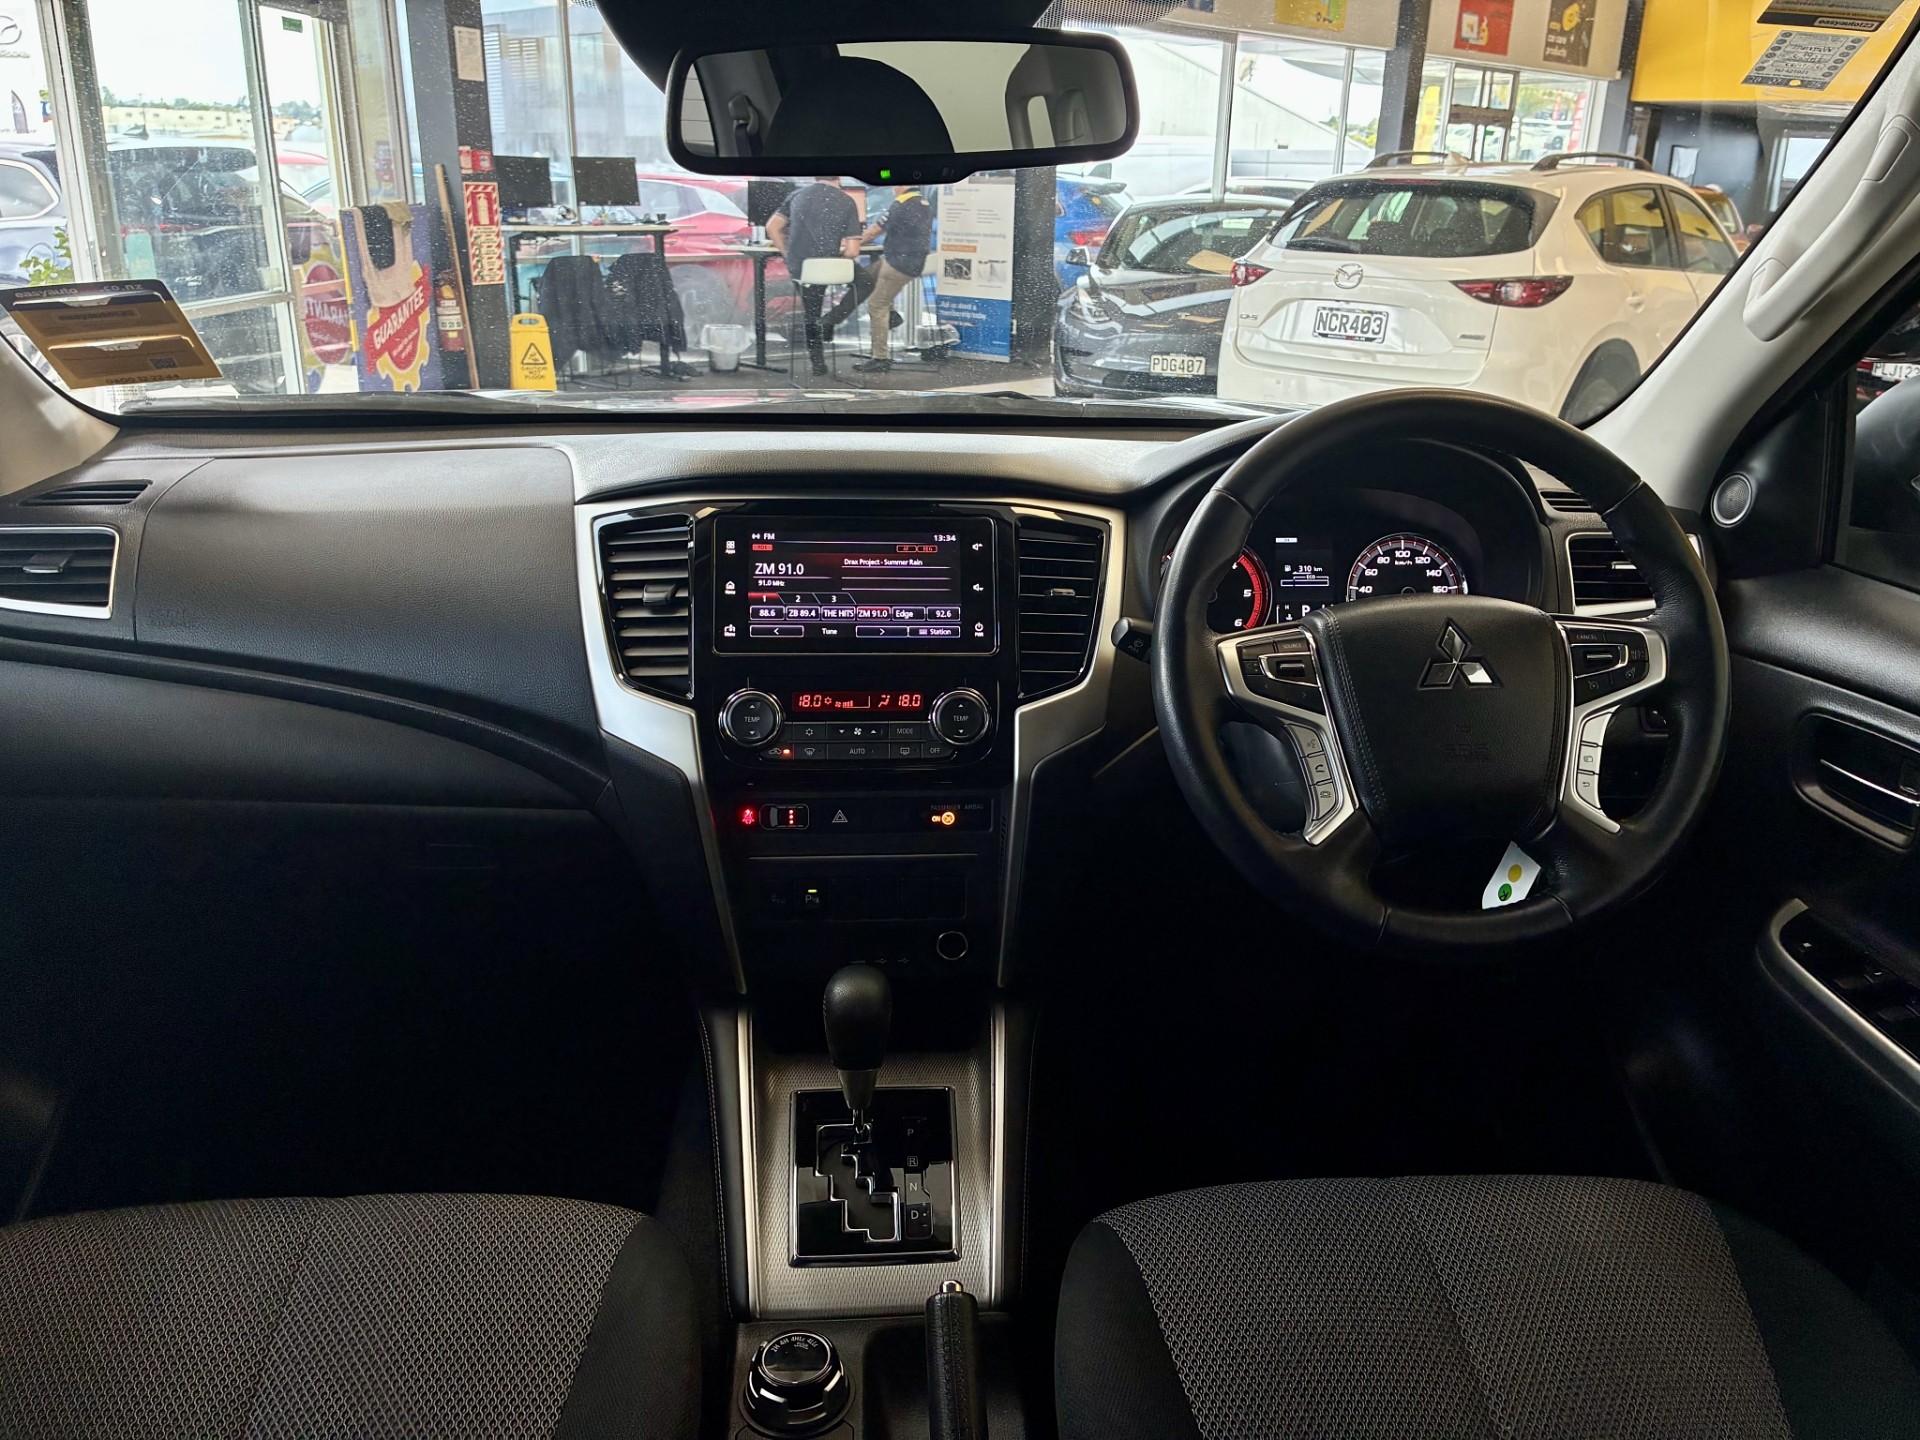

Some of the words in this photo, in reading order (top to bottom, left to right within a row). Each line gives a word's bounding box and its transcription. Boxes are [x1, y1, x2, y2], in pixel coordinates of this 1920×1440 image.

[373, 285, 424, 350] GUARANTEE
[1317, 312, 1384, 336] NCR403
[1394, 550, 1411, 558] 100
[844, 558, 857, 566] Drax
[858, 558, 879, 567] Project
[884, 558, 908, 566] Summer
[909, 558, 923, 566] Rain
[755, 563, 775, 575] ZM
[778, 563, 804, 575] 91.0
[1426, 569, 1442, 577] 140
[1243, 589, 1252, 597] 5
[1358, 585, 1373, 593] 40
[1432, 585, 1448, 593] 160
[759, 609, 776, 617] 88.6
[869, 610, 888, 618] 91.0
[895, 610, 914, 619] Edge
[936, 610, 952, 618] 92.6
[1301, 604, 1311, 617] P
[1234, 619, 1243, 627] 6
[797, 695, 822, 708] 18.0
[898, 694, 921, 708] 18.0
[907, 1129, 914, 1137] P
[910, 1157, 916, 1165] R
[910, 1183, 918, 1191] N
[911, 1210, 919, 1219] D
